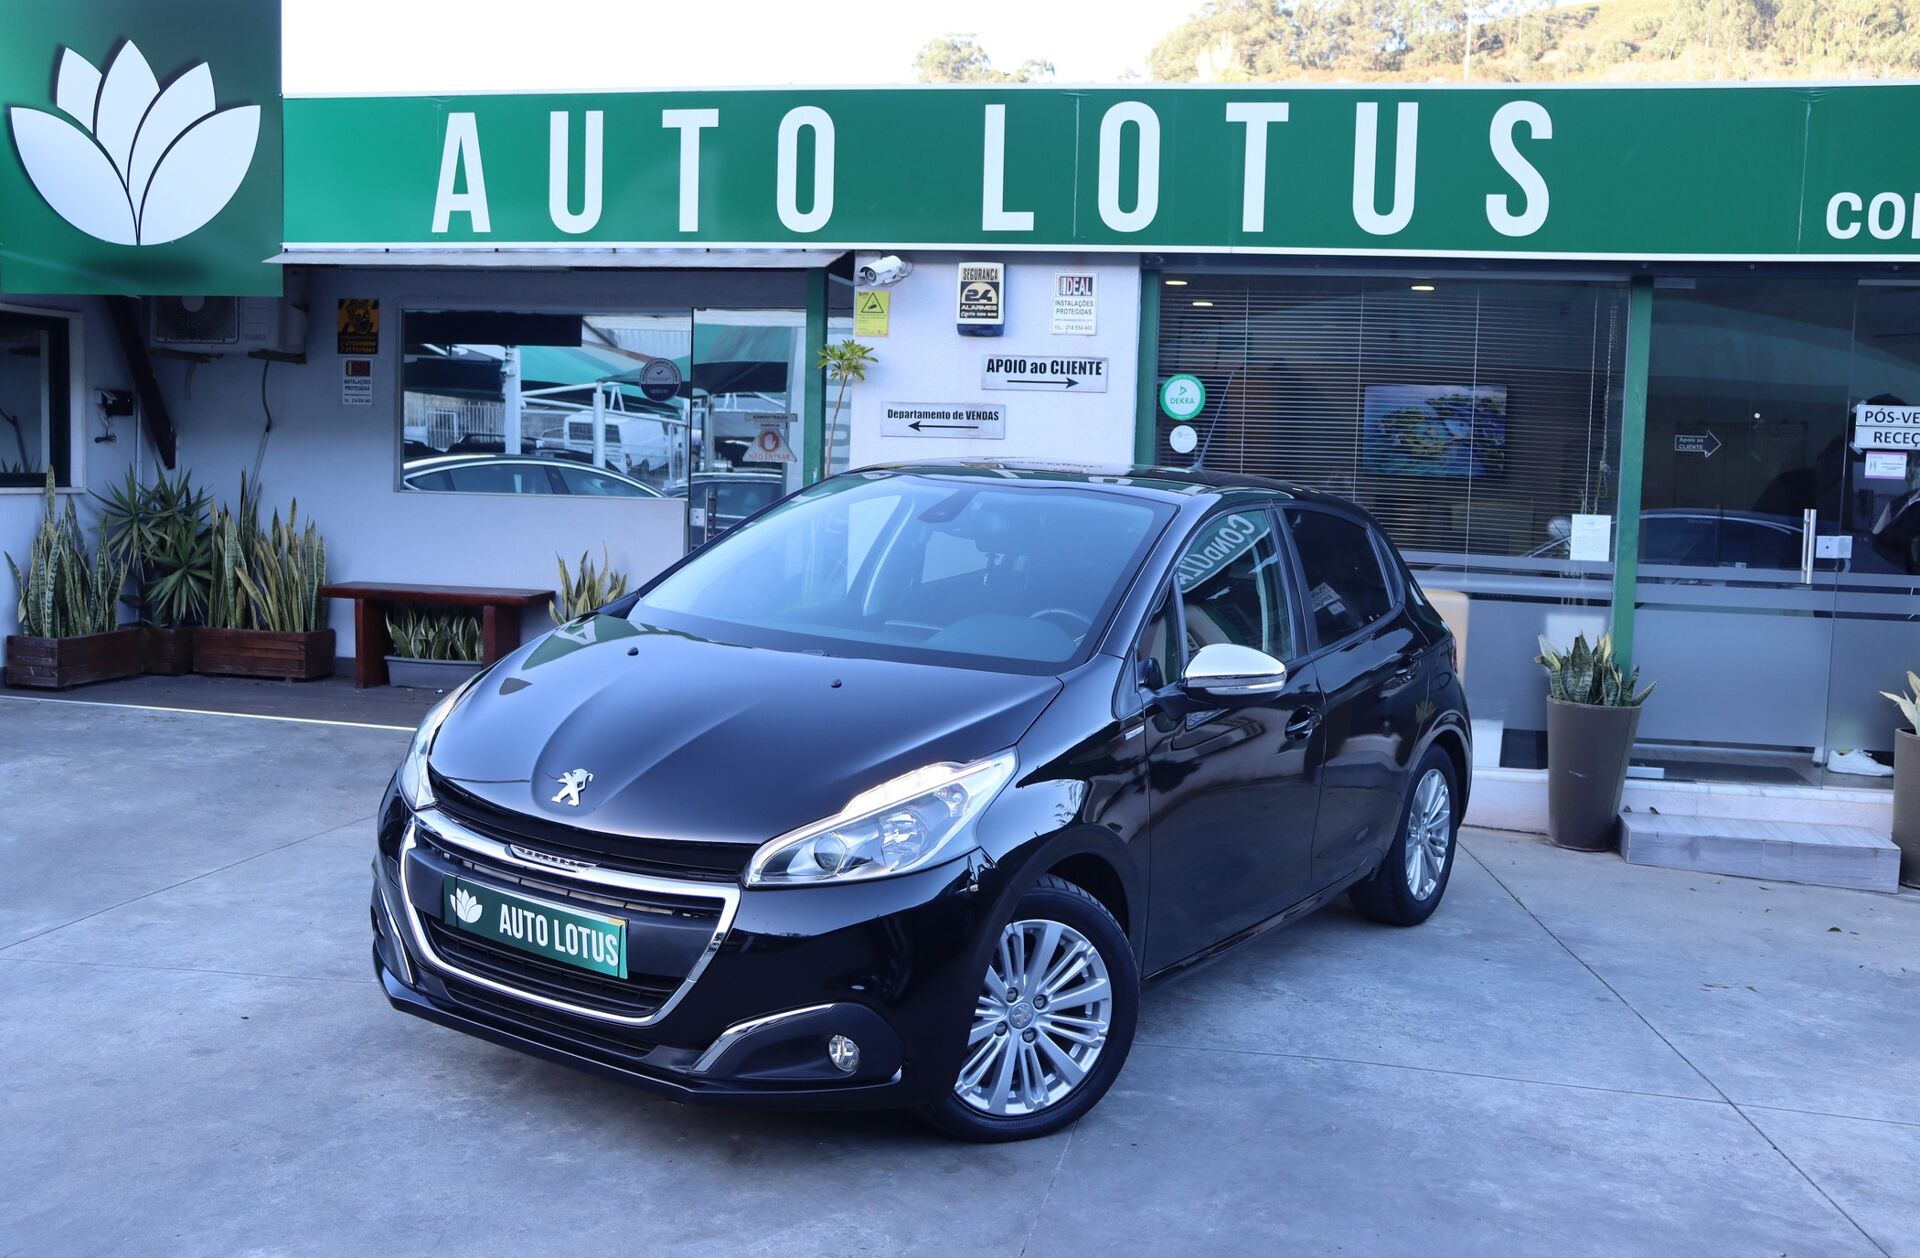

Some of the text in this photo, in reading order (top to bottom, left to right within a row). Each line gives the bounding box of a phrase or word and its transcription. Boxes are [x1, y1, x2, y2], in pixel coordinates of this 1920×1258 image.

[432, 101, 1552, 236] AUTO LOTUS
[1827, 193, 1920, 239] CO
[963, 268, 998, 281] SEGURANÇA
[965, 289, 992, 302] 24
[1055, 300, 1094, 308] INSTALAÇÕES
[986, 359, 1102, 376] APOIO ao CLIENTE
[1170, 397, 1195, 405] DEKRA
[887, 409, 999, 421] Departamento de VENDAS
[500, 904, 619, 967] AUTO LOTUS
